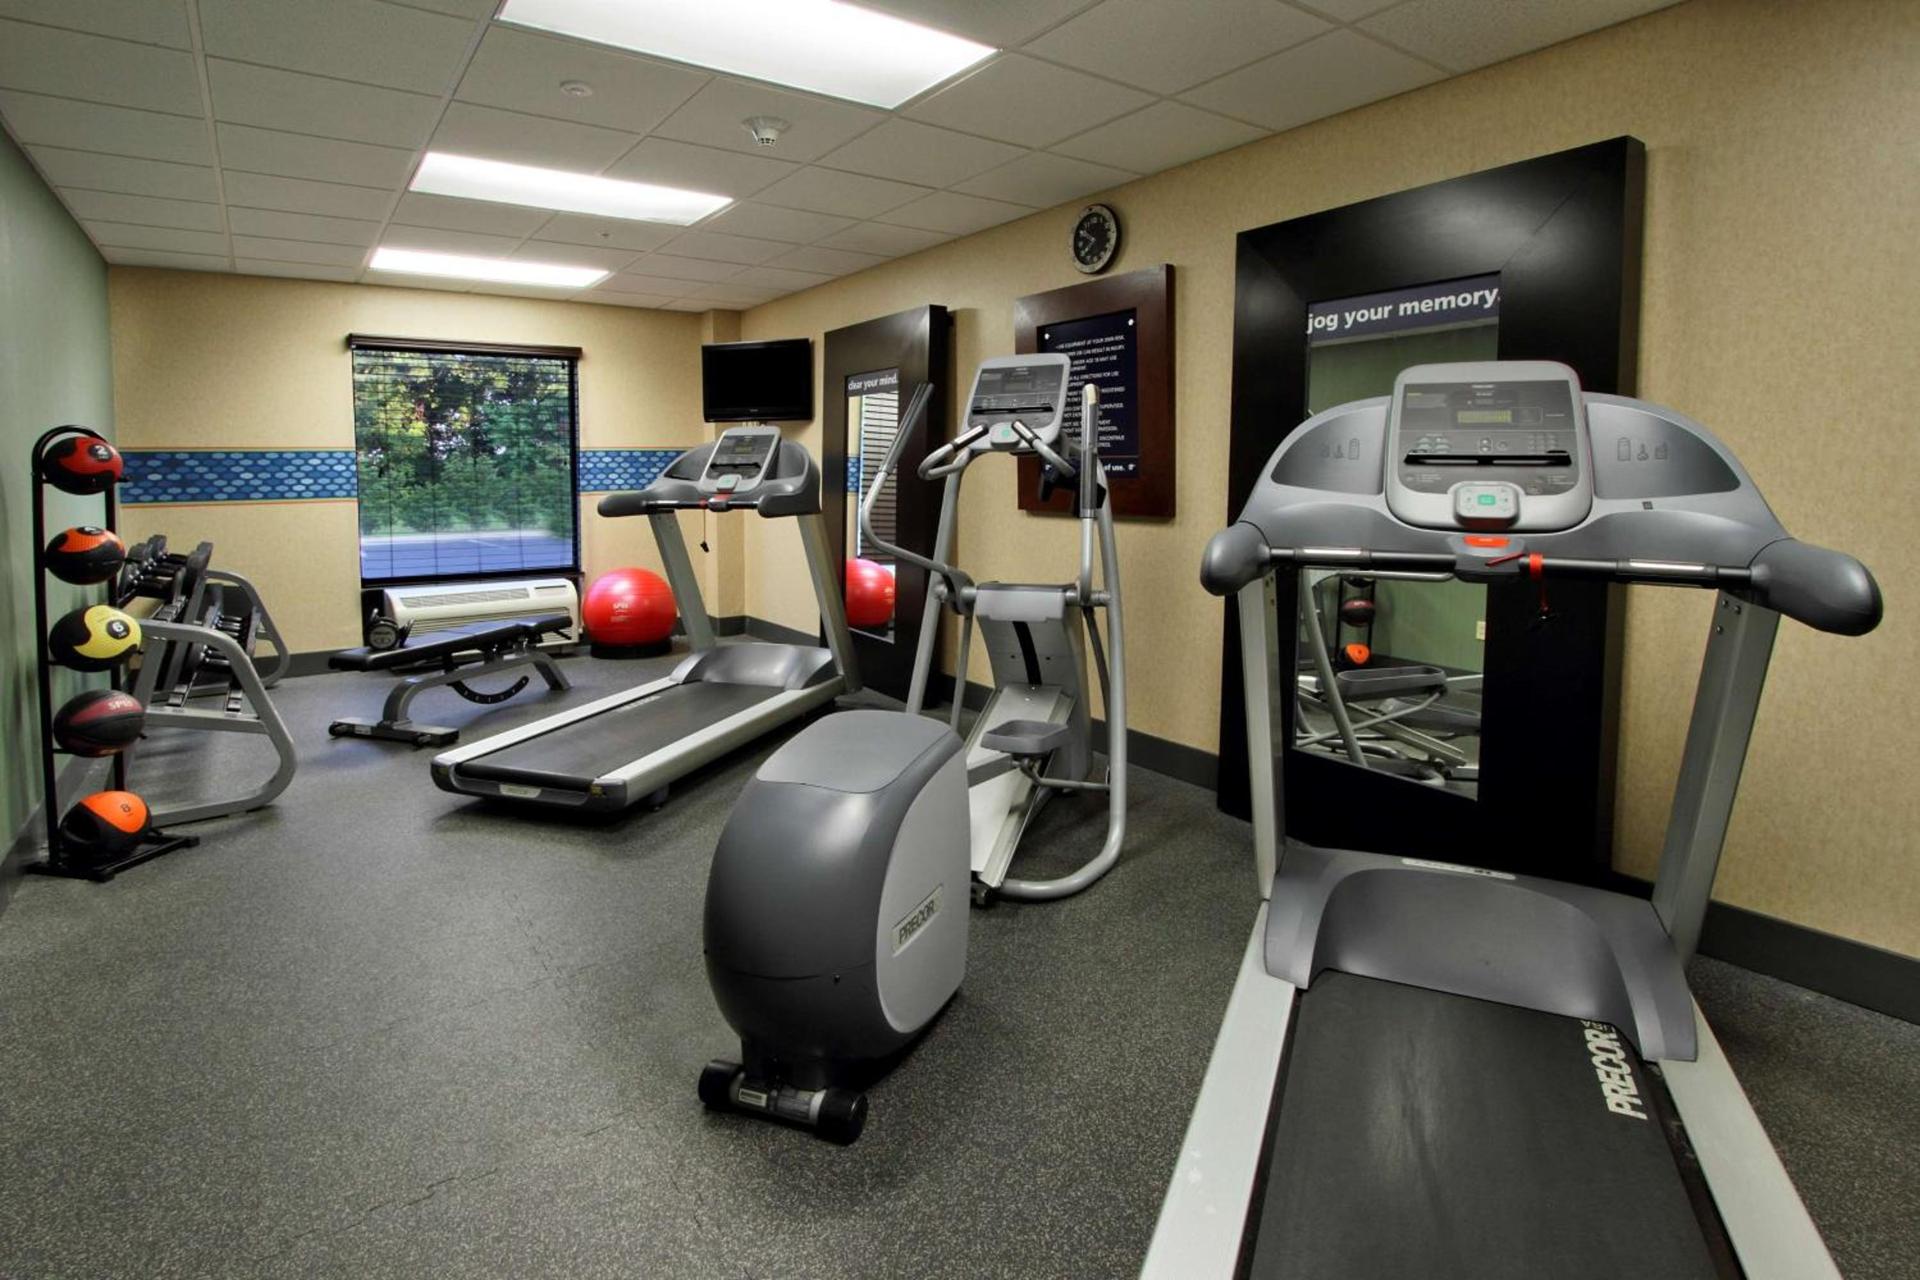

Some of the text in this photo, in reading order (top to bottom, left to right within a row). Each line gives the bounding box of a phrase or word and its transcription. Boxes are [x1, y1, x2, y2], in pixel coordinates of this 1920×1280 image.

[1306, 313, 1338, 334] jog
[1344, 304, 1393, 328] your
[95, 444, 108, 455] 2
[112, 621, 124, 632] 6
[120, 803, 131, 812] 8
[1583, 1028, 1649, 1120] PRECOR
